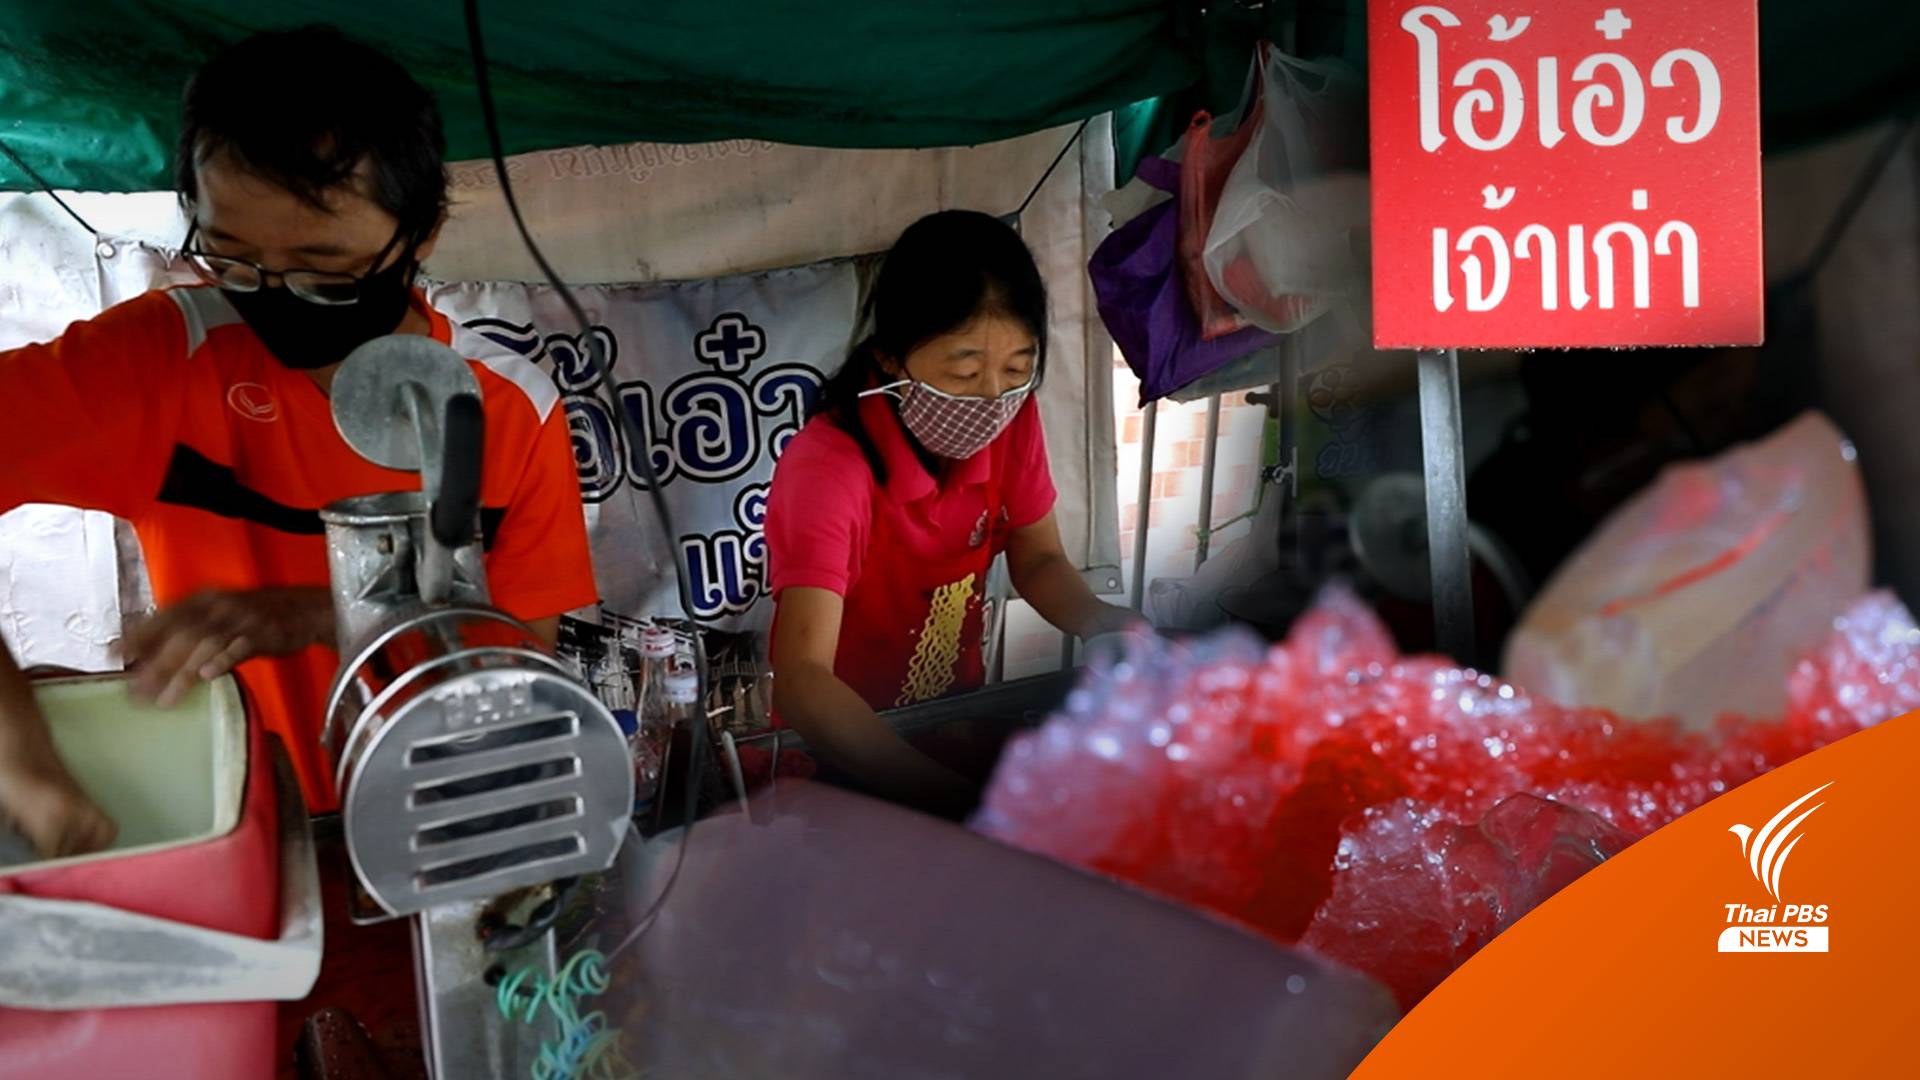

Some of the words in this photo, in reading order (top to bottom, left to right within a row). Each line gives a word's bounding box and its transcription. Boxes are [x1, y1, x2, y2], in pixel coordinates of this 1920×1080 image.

[1401, 6, 1721, 152] โอ้เอ๋ว
[1432, 184, 1700, 312] เจ้าเก่า
